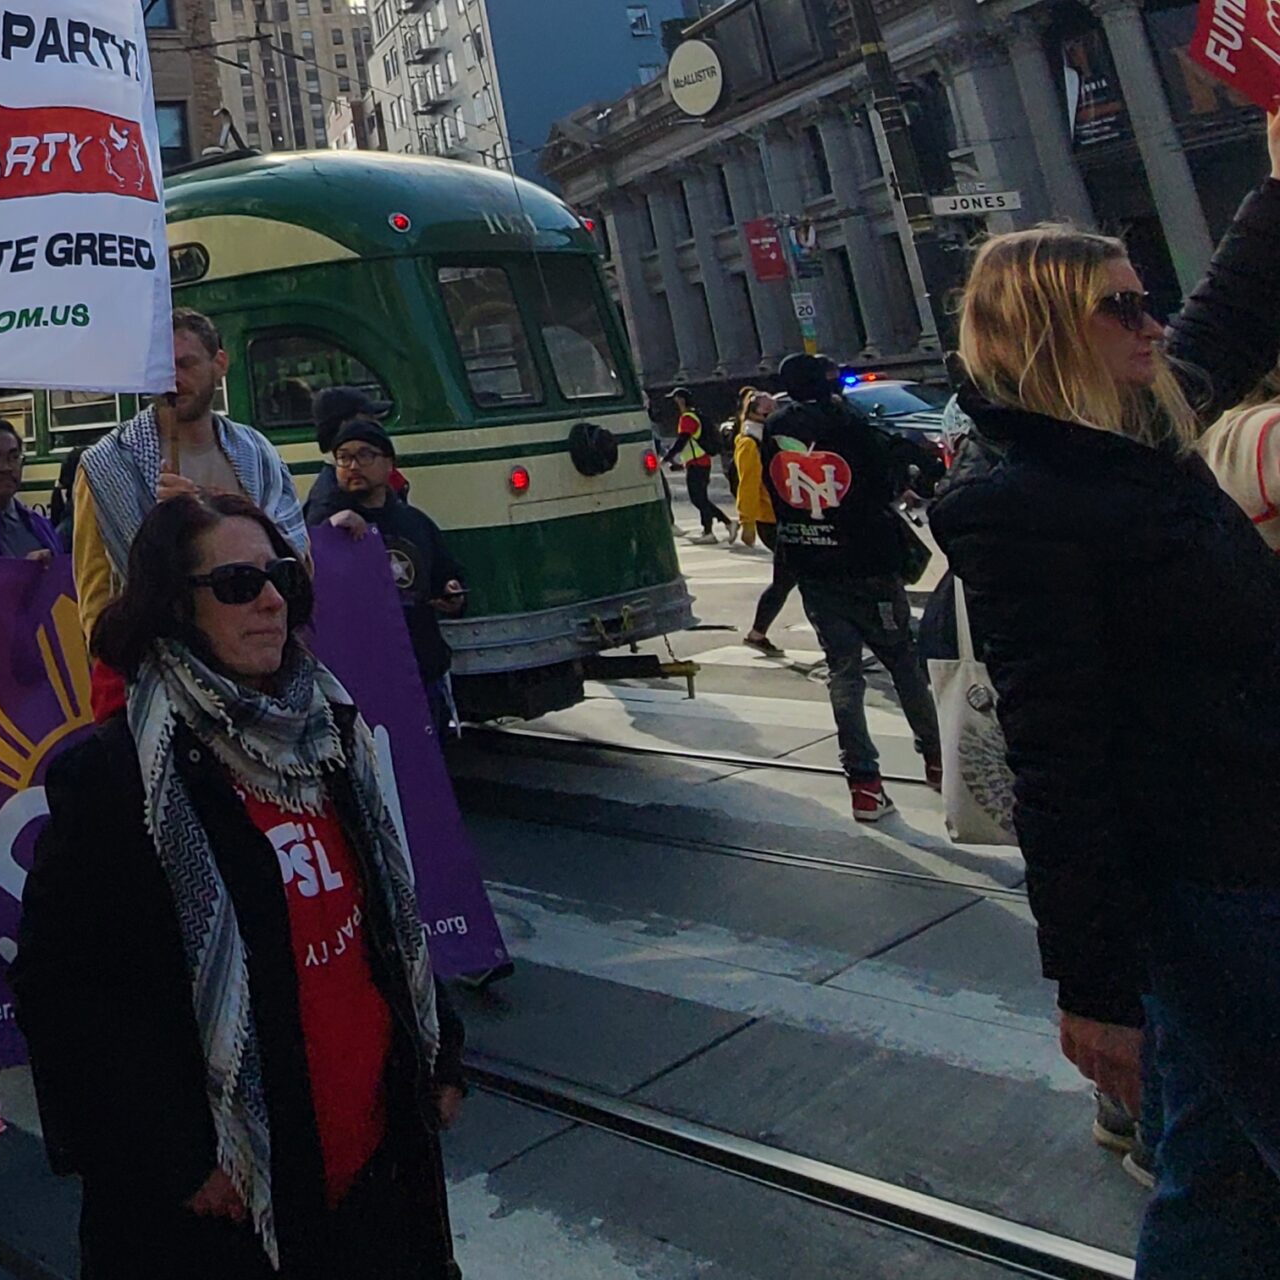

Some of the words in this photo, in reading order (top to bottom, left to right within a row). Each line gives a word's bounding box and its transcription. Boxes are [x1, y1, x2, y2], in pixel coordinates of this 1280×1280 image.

[672, 65, 718, 89] McALLISTER
[949, 196, 1006, 211] JONES
[44, 232, 157, 272] GREED
[798, 305, 814, 317] 20
